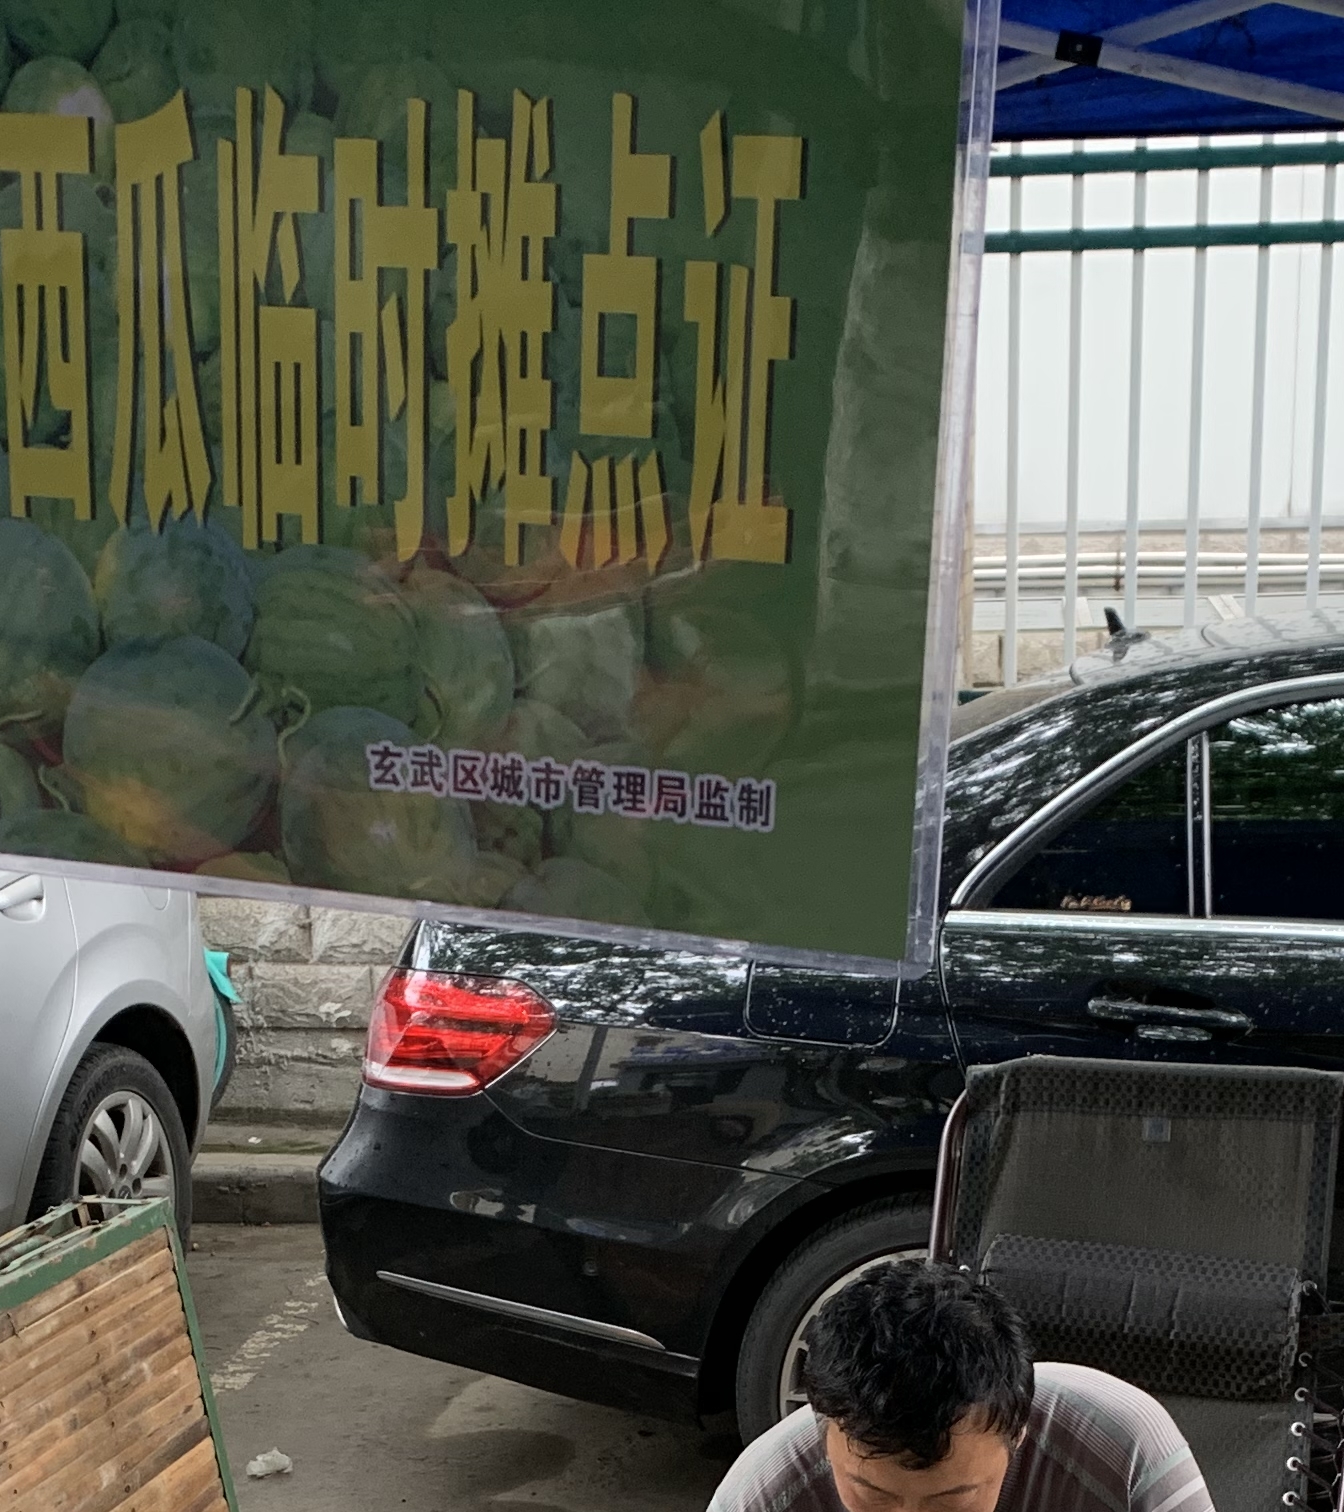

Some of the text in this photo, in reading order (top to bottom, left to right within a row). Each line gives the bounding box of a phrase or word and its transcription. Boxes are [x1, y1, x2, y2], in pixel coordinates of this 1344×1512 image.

[368, 743, 774, 831] 玄武区城市管理局监制
